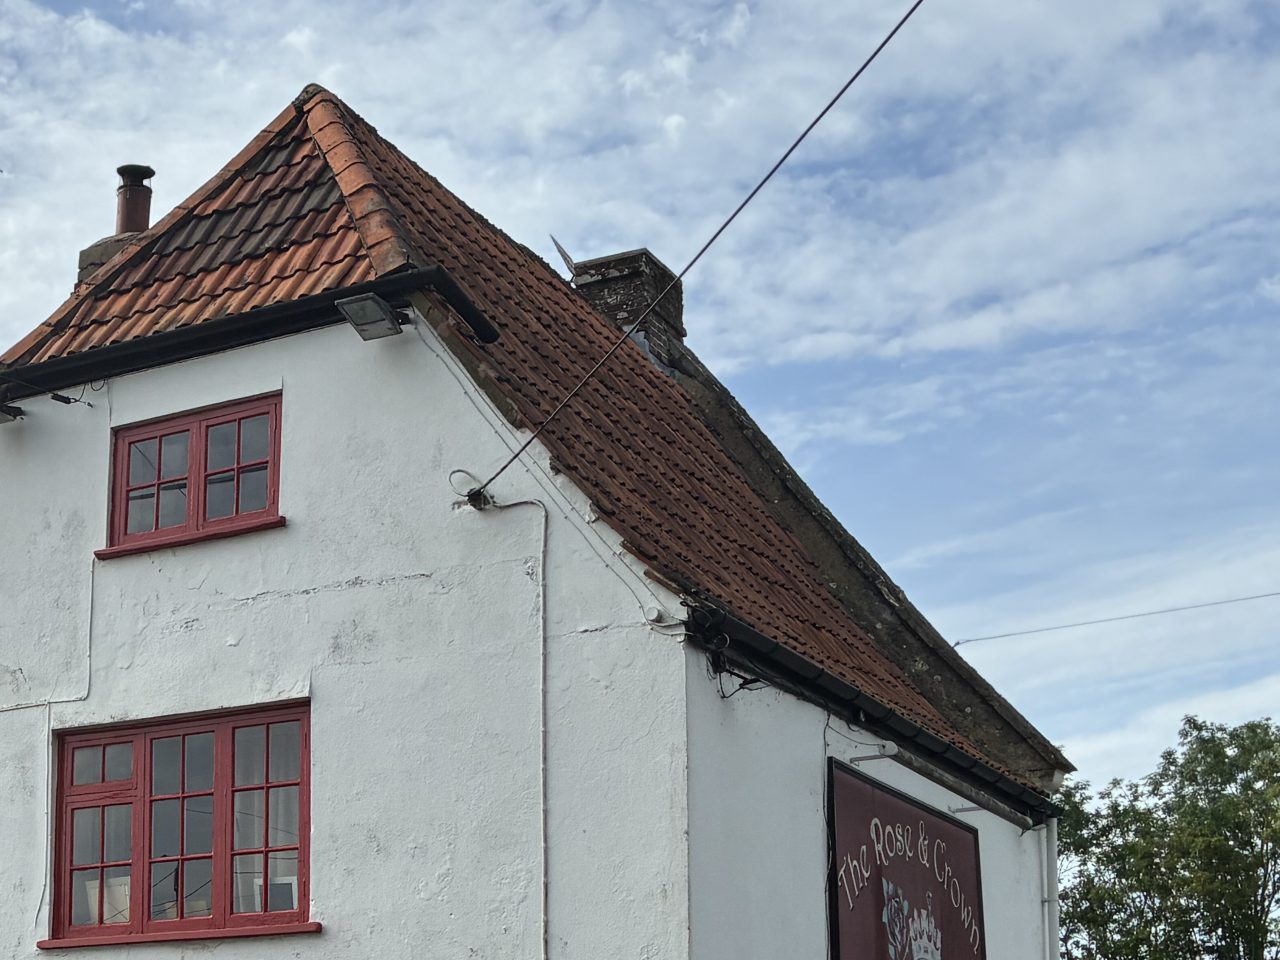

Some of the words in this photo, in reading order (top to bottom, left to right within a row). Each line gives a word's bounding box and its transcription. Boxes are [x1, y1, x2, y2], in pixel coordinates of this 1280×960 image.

[837, 844, 871, 911] The
[869, 817, 914, 866] Rose
[918, 820, 930, 869] &
[933, 838, 980, 955] Crown
